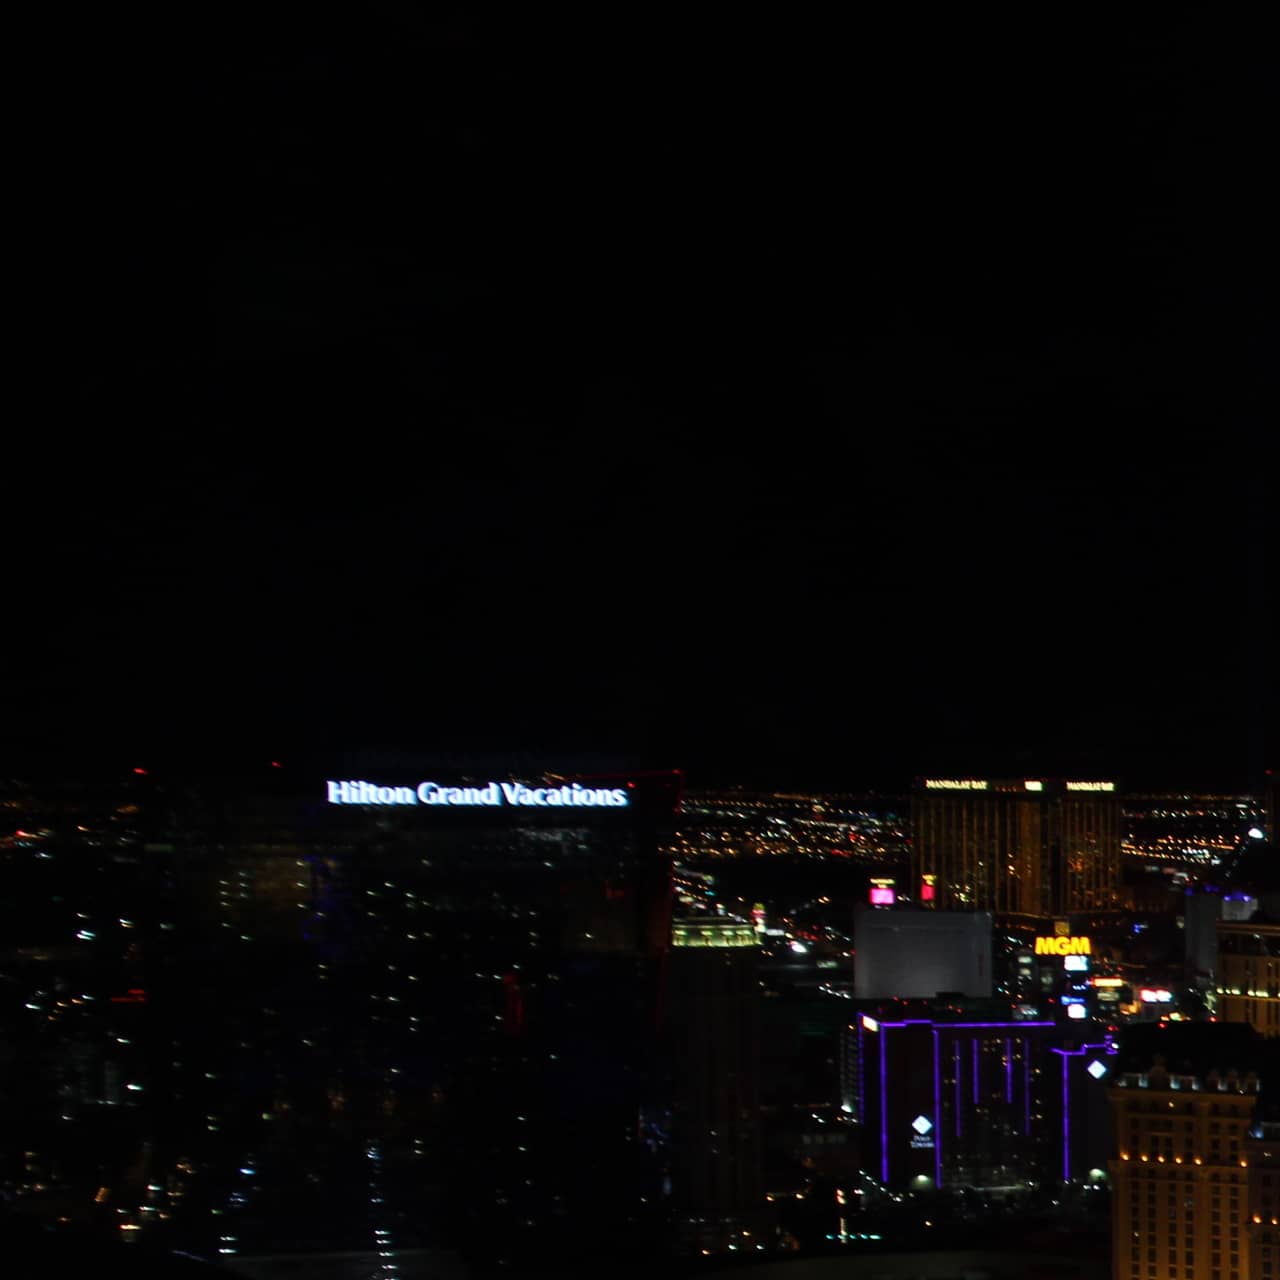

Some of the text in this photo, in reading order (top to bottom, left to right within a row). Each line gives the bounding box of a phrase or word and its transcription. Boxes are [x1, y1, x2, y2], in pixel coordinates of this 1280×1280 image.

[326, 780, 628, 806] Hilton Grand Vacations
[1035, 936, 1091, 955] MGM
